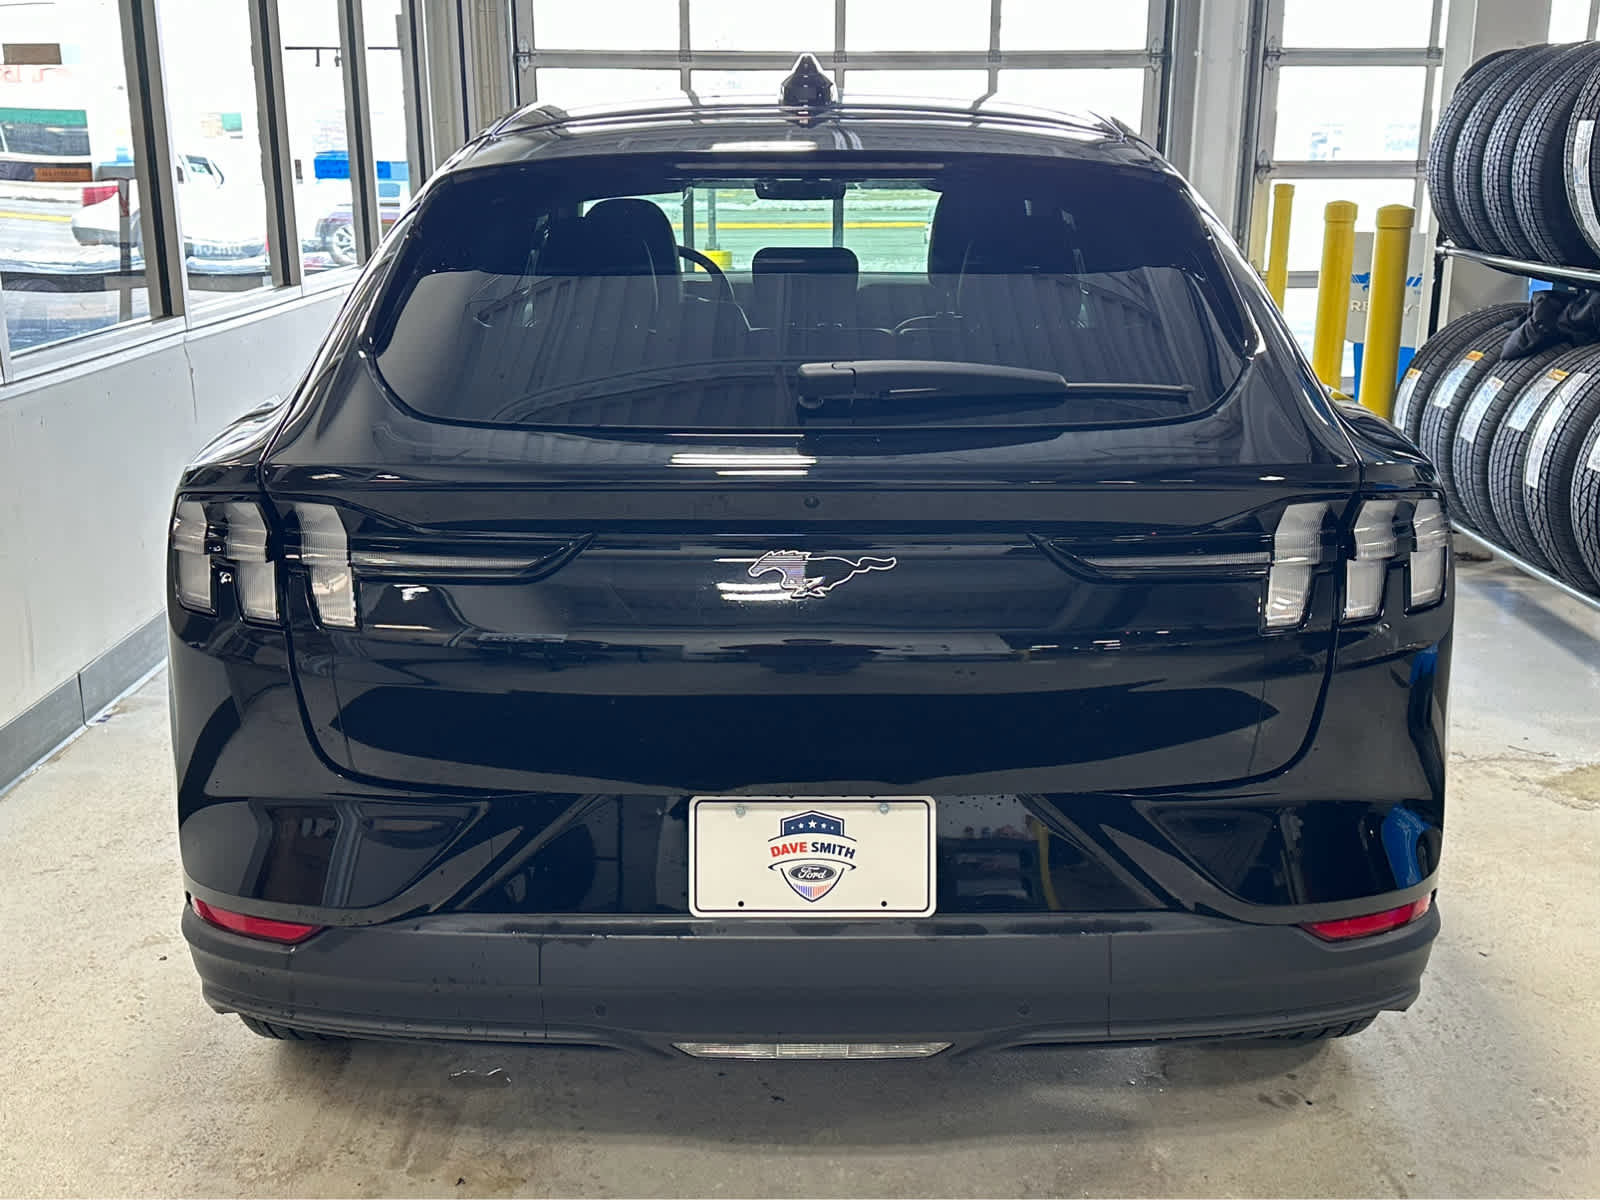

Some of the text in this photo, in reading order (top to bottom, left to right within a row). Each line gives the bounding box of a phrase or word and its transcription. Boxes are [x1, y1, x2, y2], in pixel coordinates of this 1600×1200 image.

[770, 841, 855, 859] DAVE SMITH
[797, 865, 827, 879] Ford
